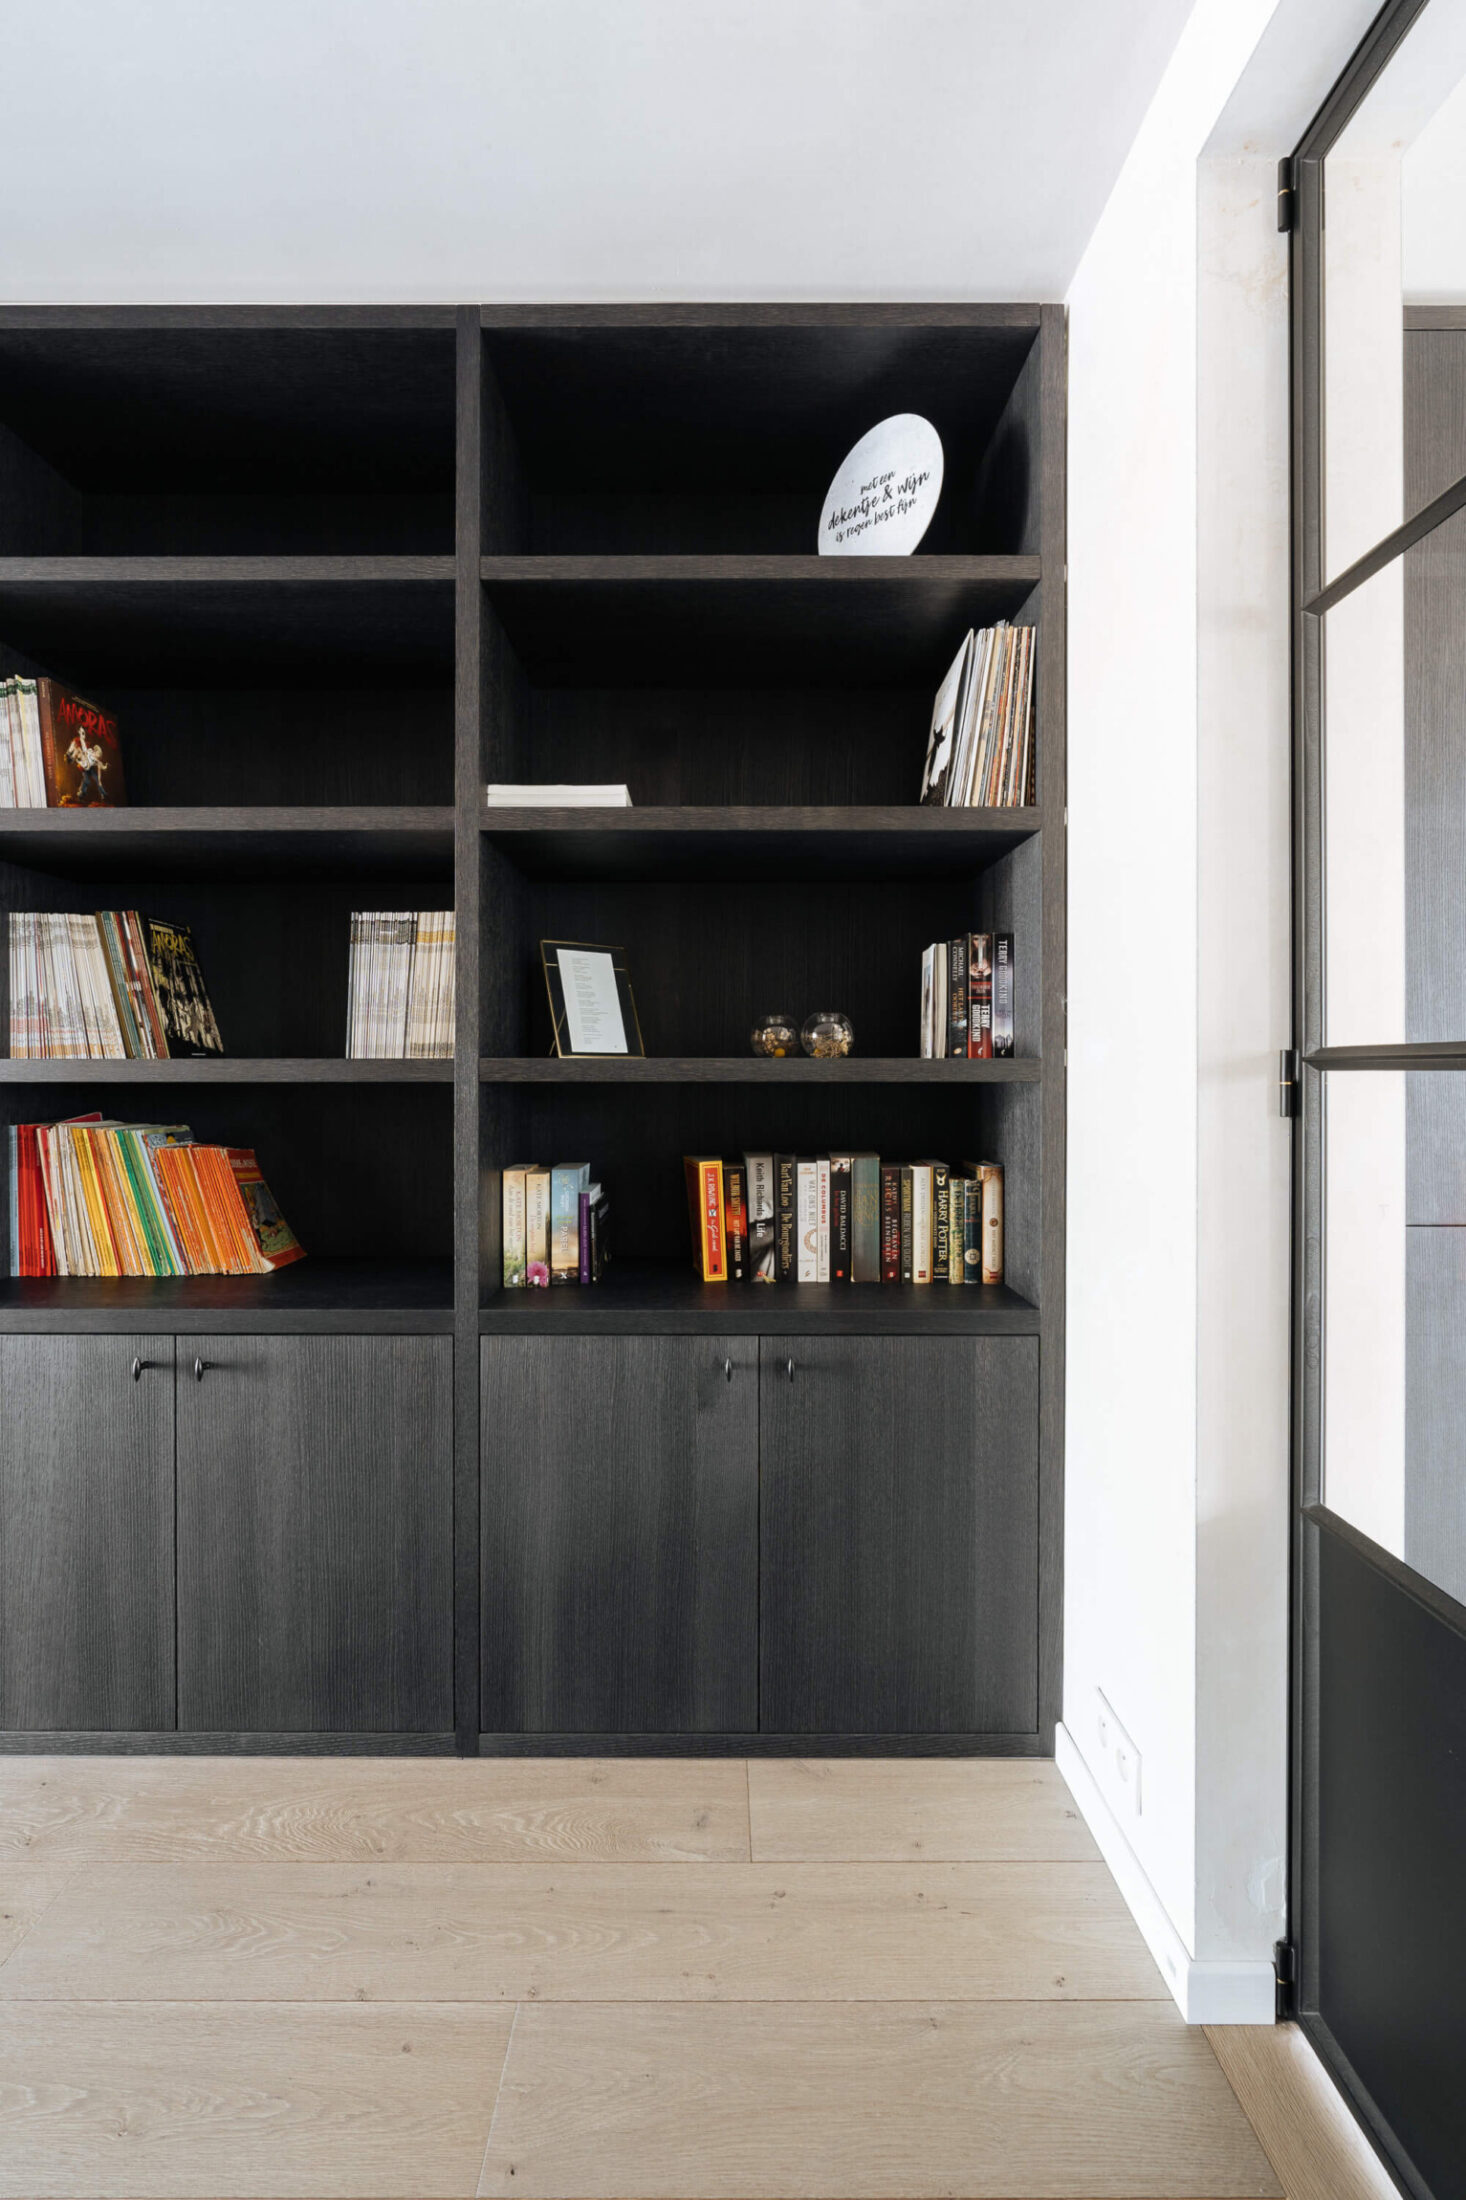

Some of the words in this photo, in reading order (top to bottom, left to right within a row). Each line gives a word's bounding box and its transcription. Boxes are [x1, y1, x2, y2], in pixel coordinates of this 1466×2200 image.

[860, 477, 877, 495] met
[879, 470, 896, 485] een
[828, 496, 880, 530] dekentje
[882, 484, 893, 503] &
[897, 470, 930, 495] wijn
[835, 529, 846, 543] is
[846, 519, 873, 538] regen
[874, 505, 896, 525] best
[897, 497, 918, 515] fijn
[57, 697, 119, 751] AMORAS
[151, 930, 195, 961] AMORAS
[998, 940, 1008, 964] TERRY
[998, 965, 1008, 1004] GOODKIND
[972, 1004, 981, 1042] GOODKIND
[981, 1004, 990, 1028] TERRY
[756, 1163, 765, 1182] Keith
[781, 1163, 792, 1178] Bart
[821, 1173, 826, 1183] DE
[708, 1183, 716, 1207] ROWLING
[730, 1174, 741, 1196] WILBUR
[781, 1178, 792, 1192] Van
[808, 1180, 816, 1193] WAT
[884, 1175, 892, 1212] REICHS
[903, 1179, 911, 1212] SPORTMAN
[731, 1197, 741, 1216] SMITH
[756, 1184, 765, 1216] Richards
[781, 1193, 792, 1206] Loo
[808, 1195, 816, 1209] ONS
[938, 1190, 948, 1223] HARRY
[781, 1213, 792, 1223] De
[808, 1212, 816, 1226] NIET
[756, 1223, 765, 1238] Life
[778, 1224, 793, 1269] Bourgondiërs
[938, 1225, 948, 1262] POTTER
